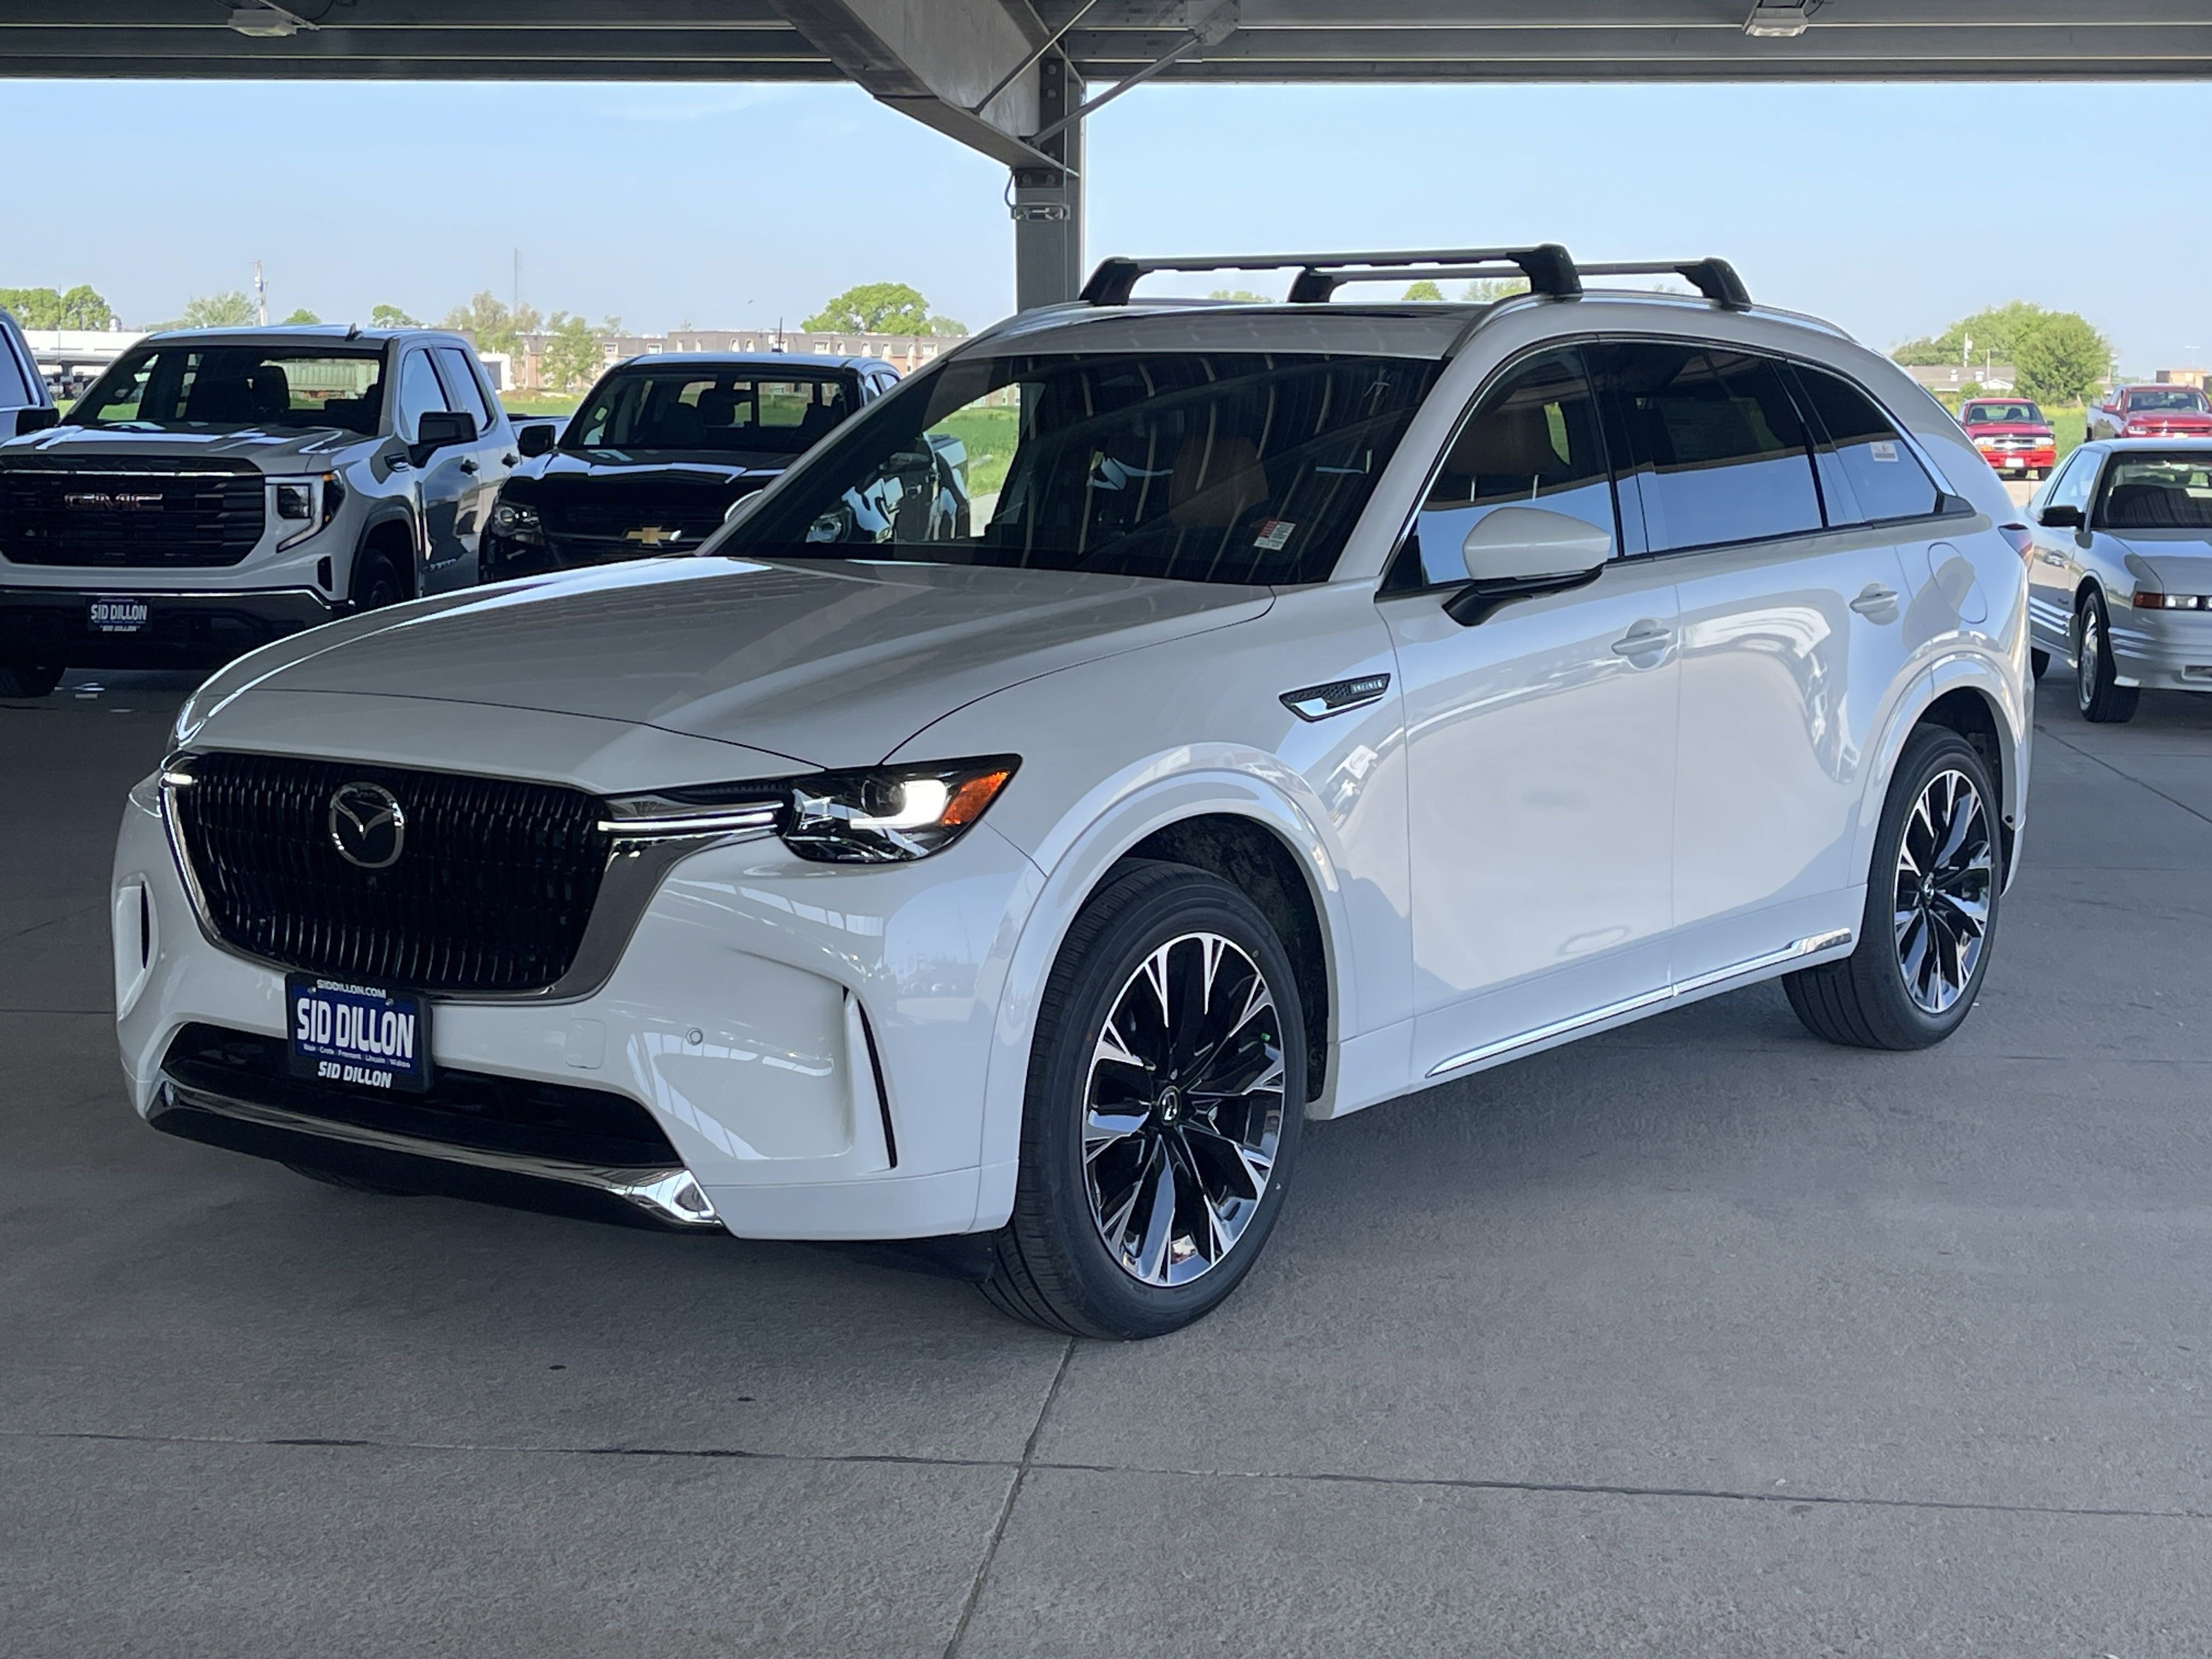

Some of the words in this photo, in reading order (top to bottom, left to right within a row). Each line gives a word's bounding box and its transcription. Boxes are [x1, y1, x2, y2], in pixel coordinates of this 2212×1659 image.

[65, 493, 163, 511] GMC
[91, 604, 109, 620] SID
[110, 604, 148, 620] DILLON
[316, 979, 386, 999] SIDDILLON.COM
[297, 997, 331, 1045] SID
[335, 1003, 415, 1059] DILLON
[317, 1060, 341, 1079] SID
[342, 1065, 393, 1089] DILLON
